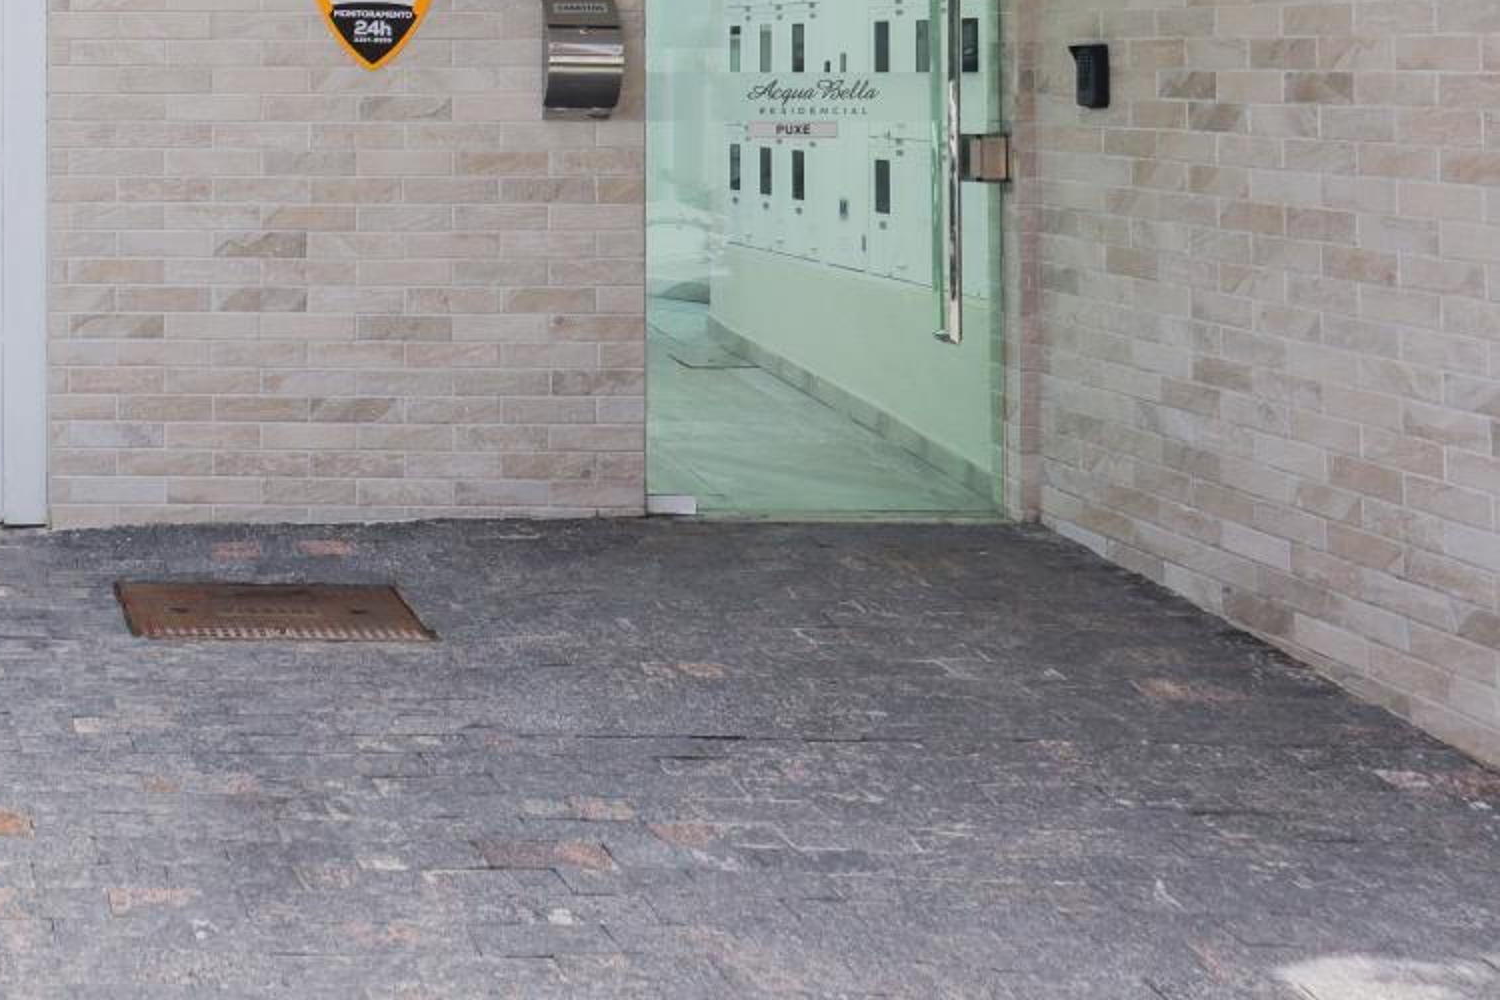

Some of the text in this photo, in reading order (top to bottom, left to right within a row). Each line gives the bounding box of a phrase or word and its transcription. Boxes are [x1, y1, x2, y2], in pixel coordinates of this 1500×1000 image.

[353, 20, 393, 37] 24h
[747, 78, 880, 105] Acqua Bella
[775, 123, 811, 135] PUXE
